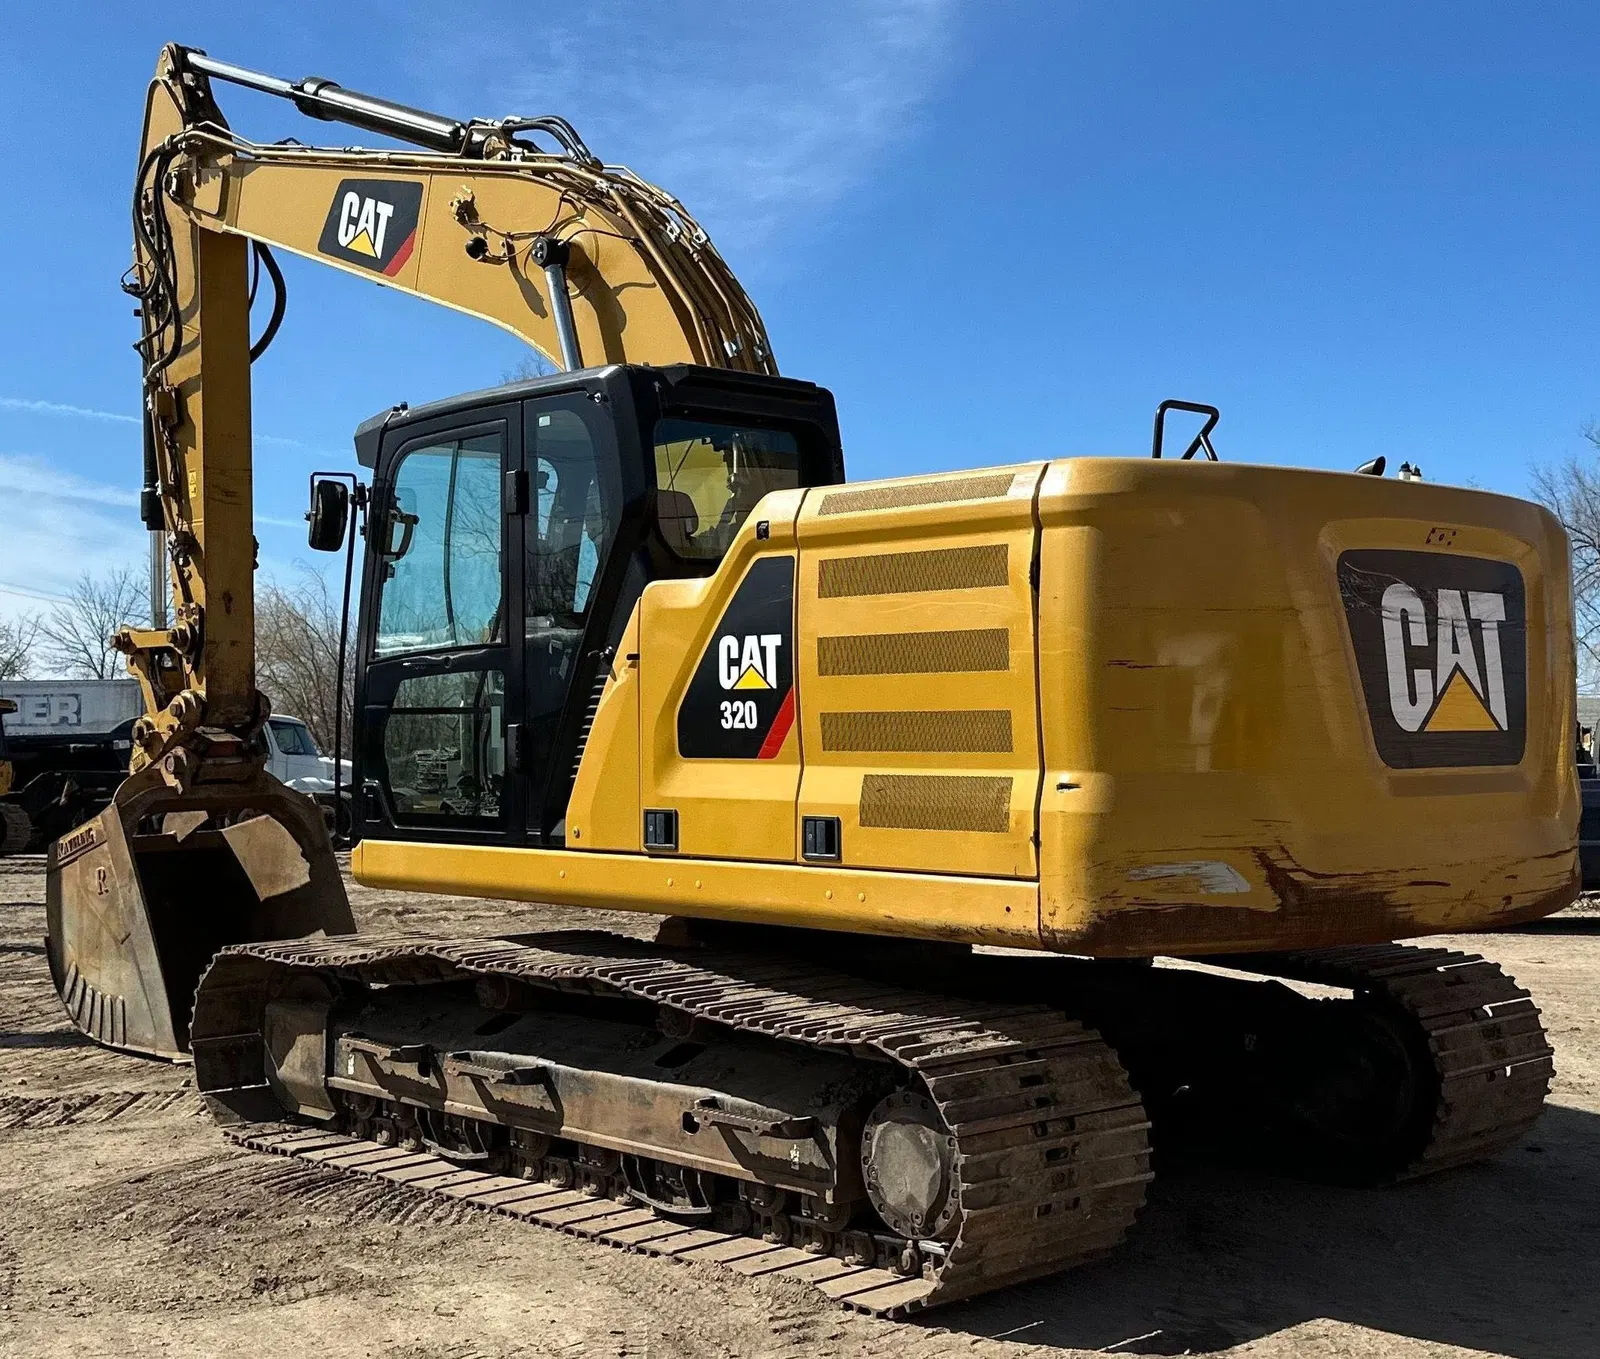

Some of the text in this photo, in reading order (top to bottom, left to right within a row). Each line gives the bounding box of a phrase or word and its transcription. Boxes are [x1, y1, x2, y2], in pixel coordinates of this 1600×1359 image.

[337, 191, 394, 260] CAT
[718, 634, 782, 690] CAT
[1381, 583, 1509, 732] CAT
[720, 700, 758, 729] 320
